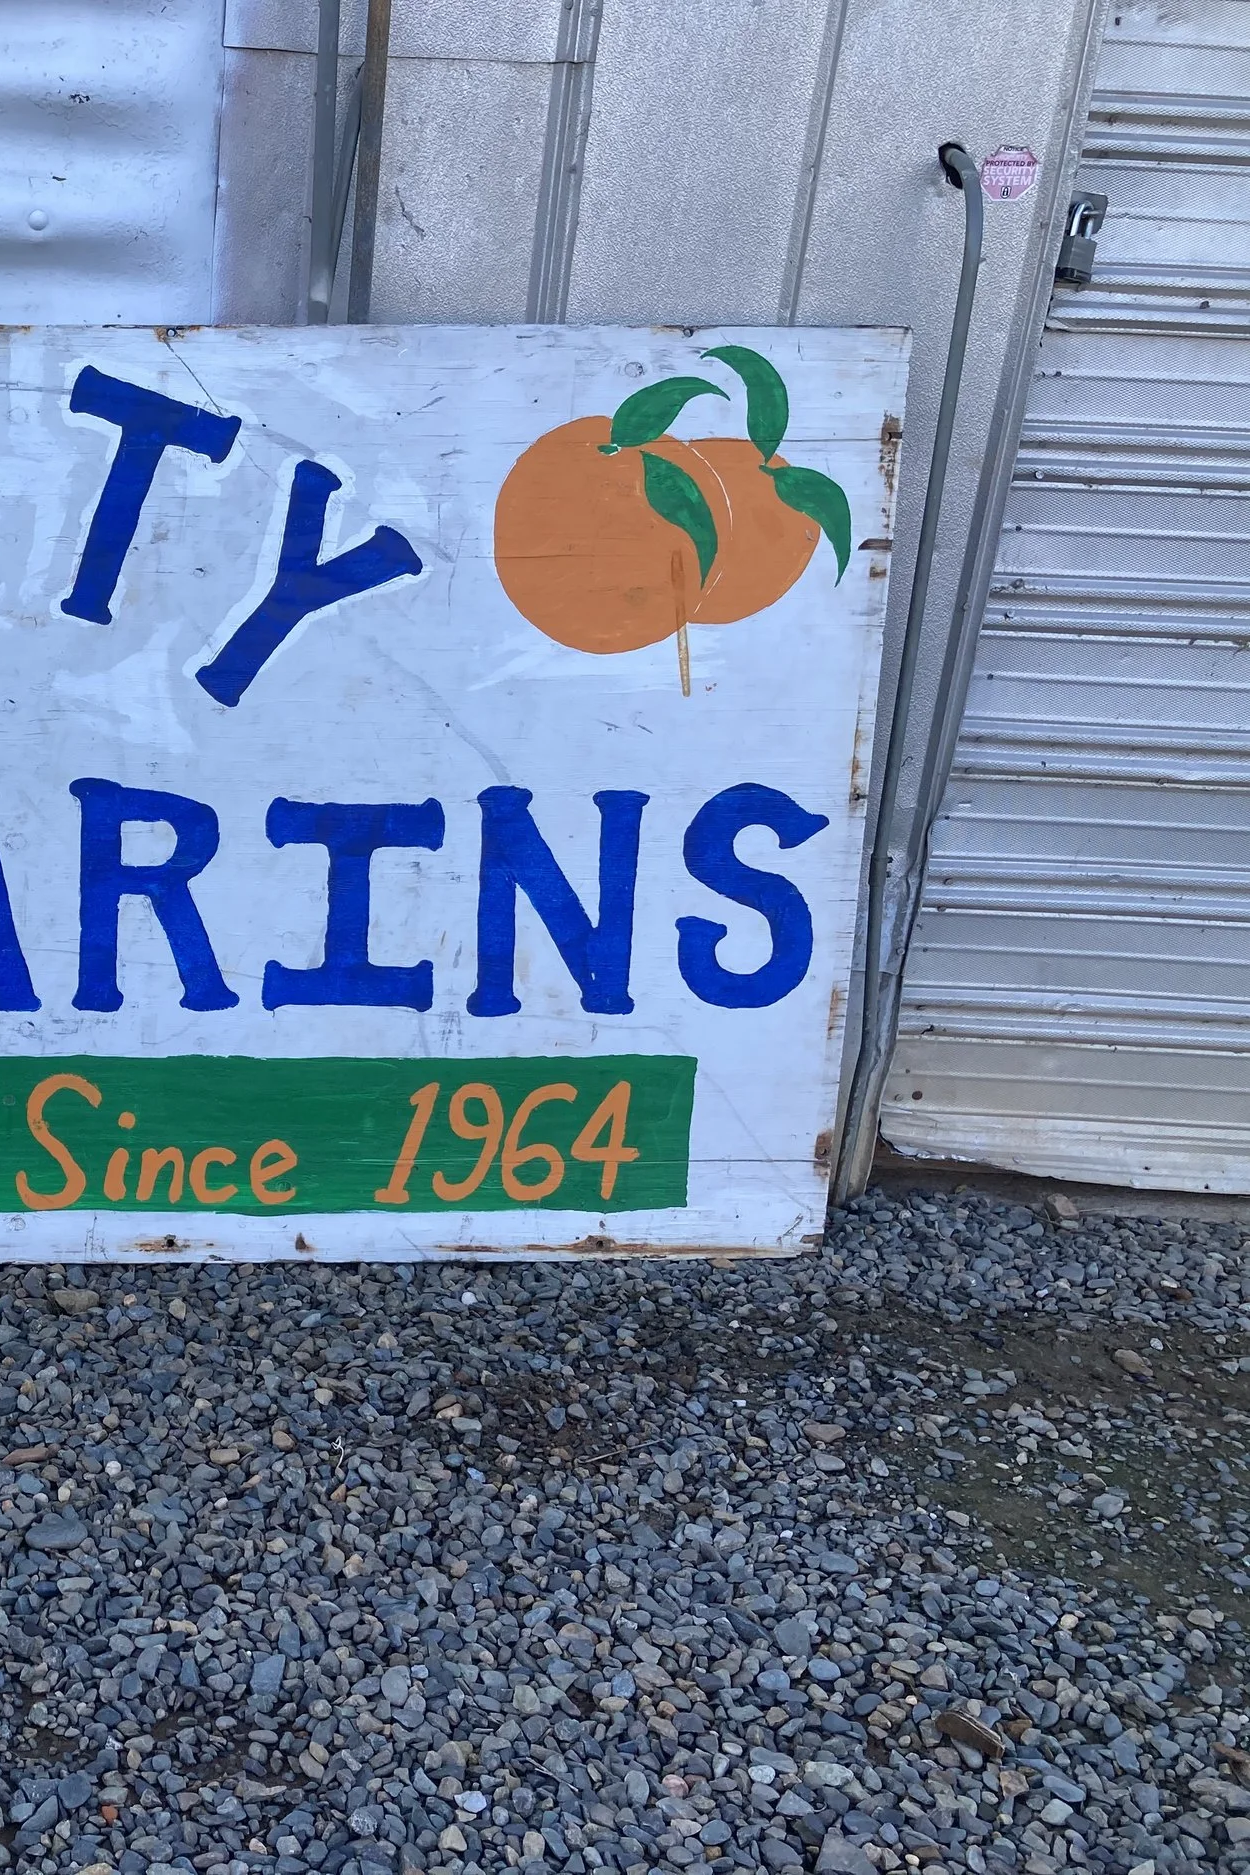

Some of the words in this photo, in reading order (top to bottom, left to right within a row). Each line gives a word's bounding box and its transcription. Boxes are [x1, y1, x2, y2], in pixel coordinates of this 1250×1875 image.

[983, 166, 1035, 175] SECURITY
[983, 175, 1032, 186] SYSTEM
[16, 1073, 298, 1211] Since
[374, 1079, 640, 1206] 1964
